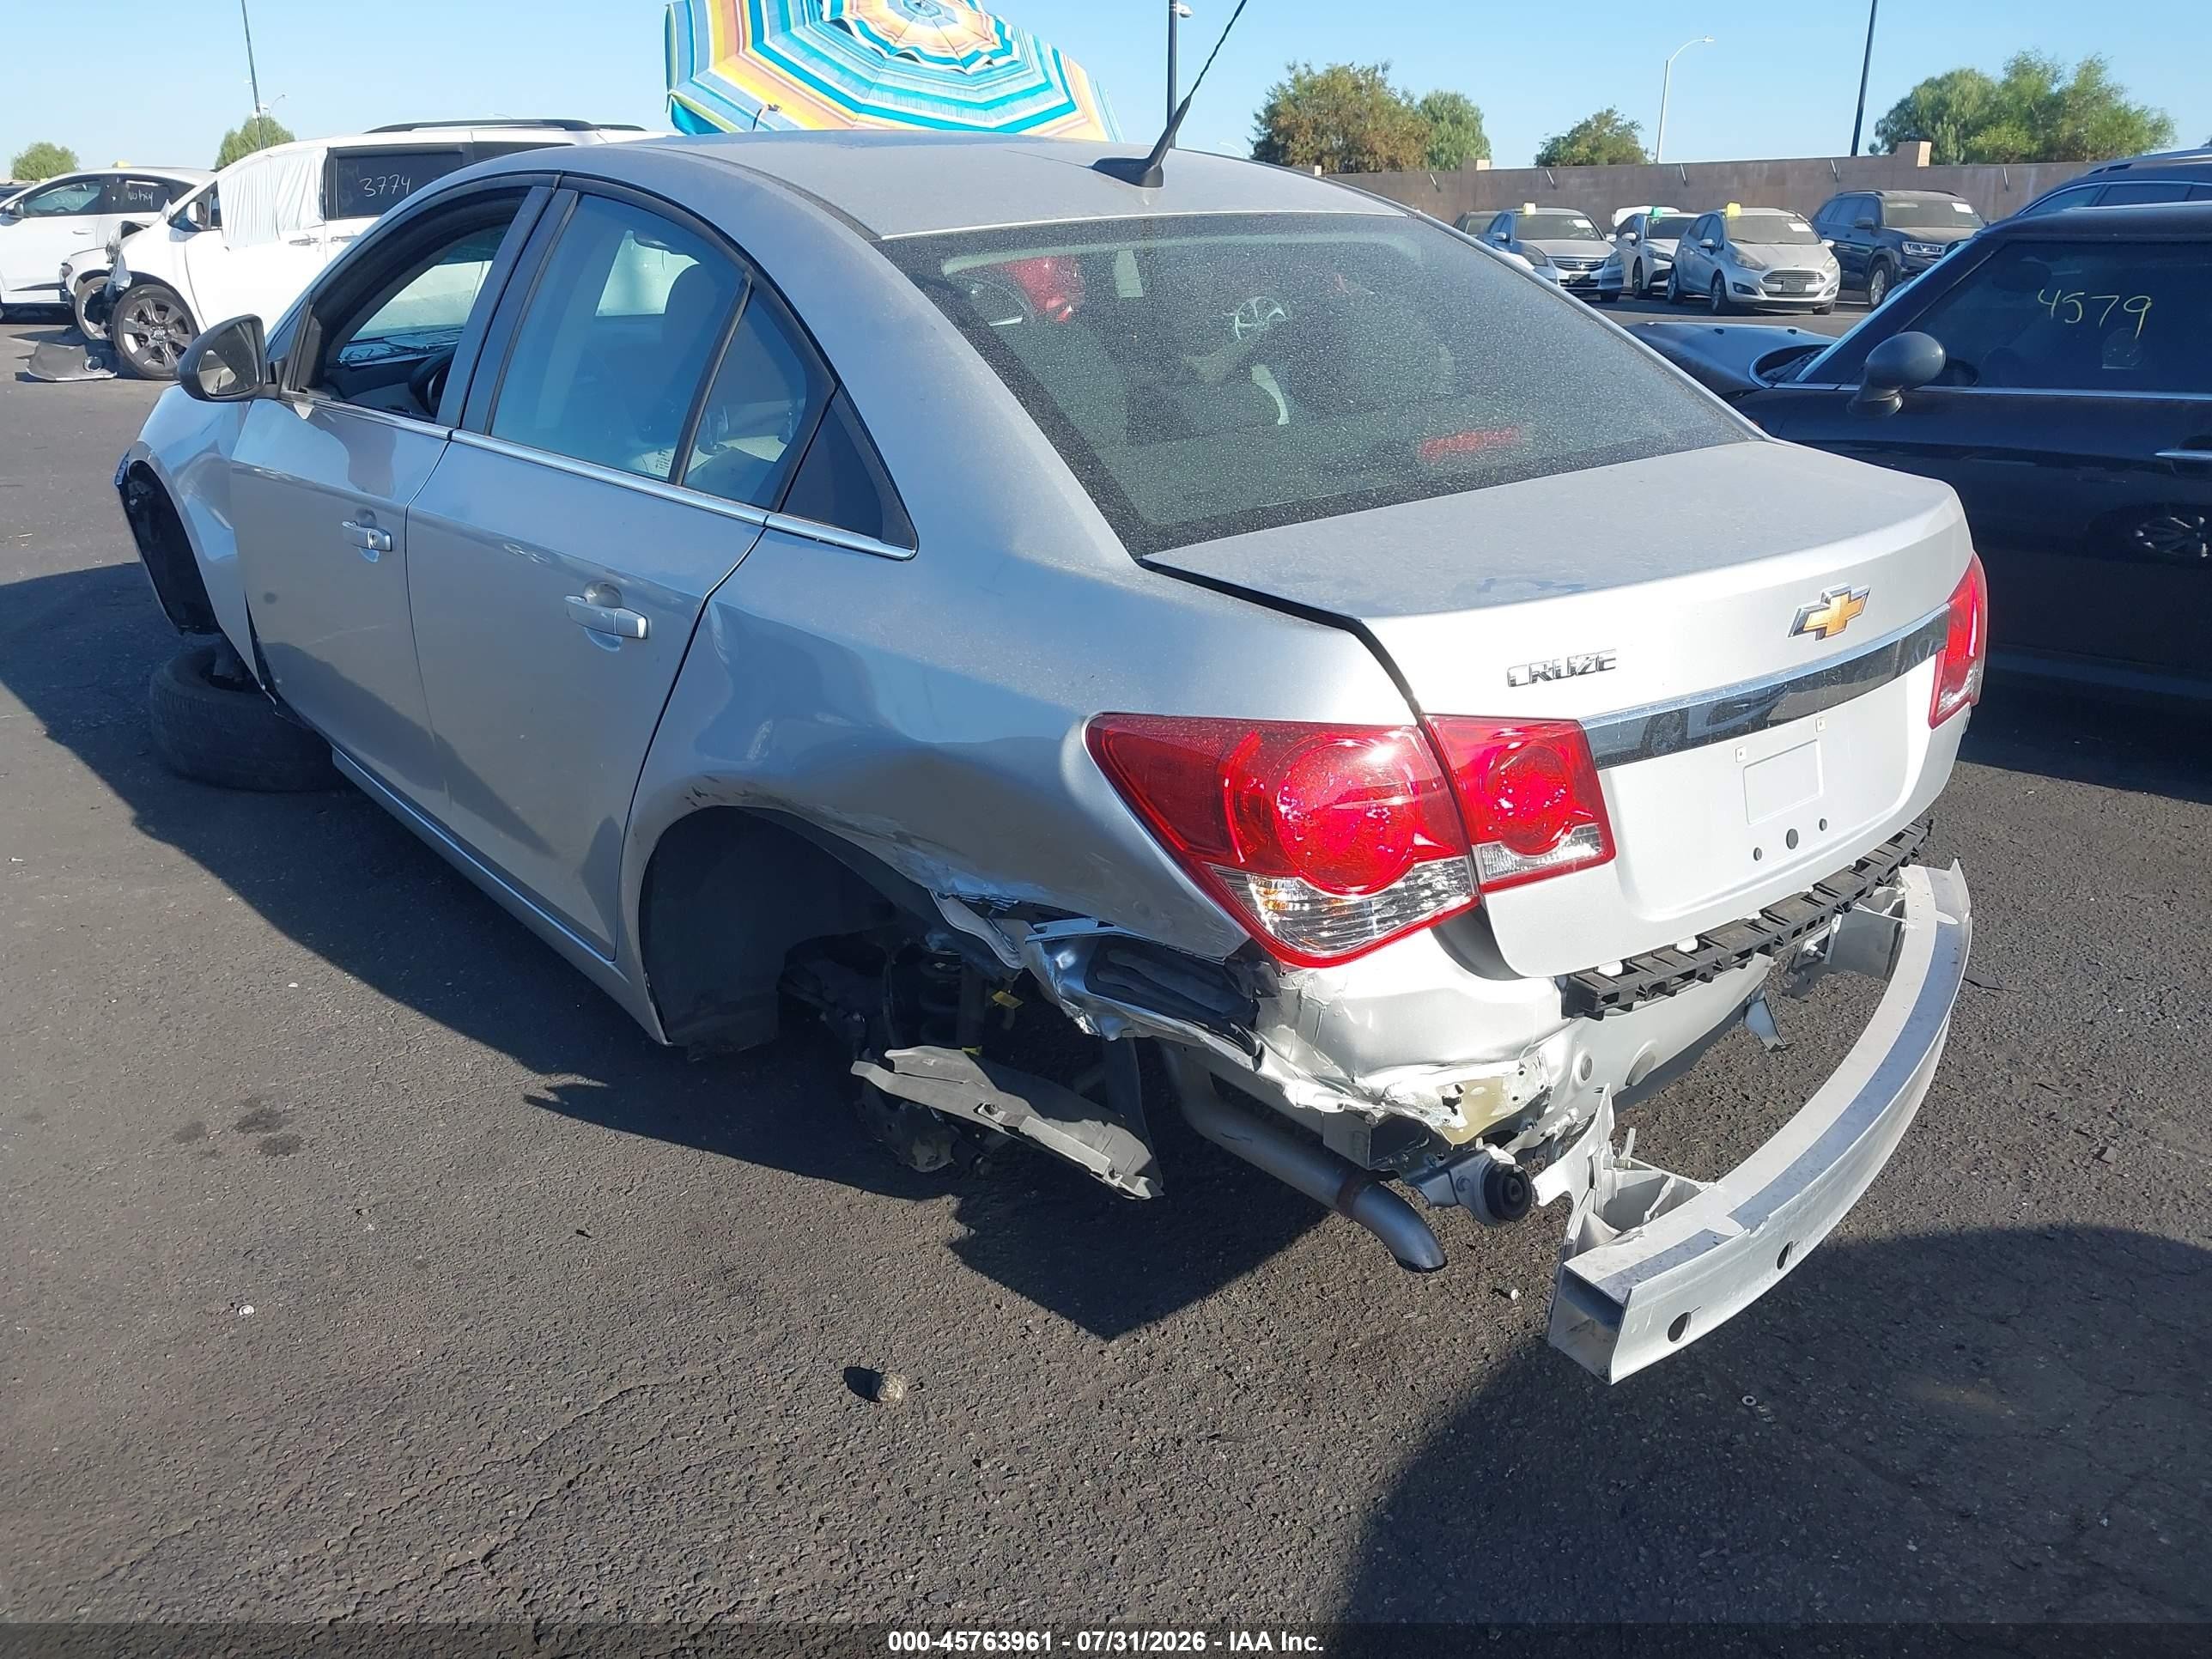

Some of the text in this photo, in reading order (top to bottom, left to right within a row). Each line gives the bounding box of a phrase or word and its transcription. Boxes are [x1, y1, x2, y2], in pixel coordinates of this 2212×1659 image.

[359, 174, 411, 197] 3774
[2038, 289, 2152, 339] 4579
[1507, 648, 1617, 688] CRUZE
